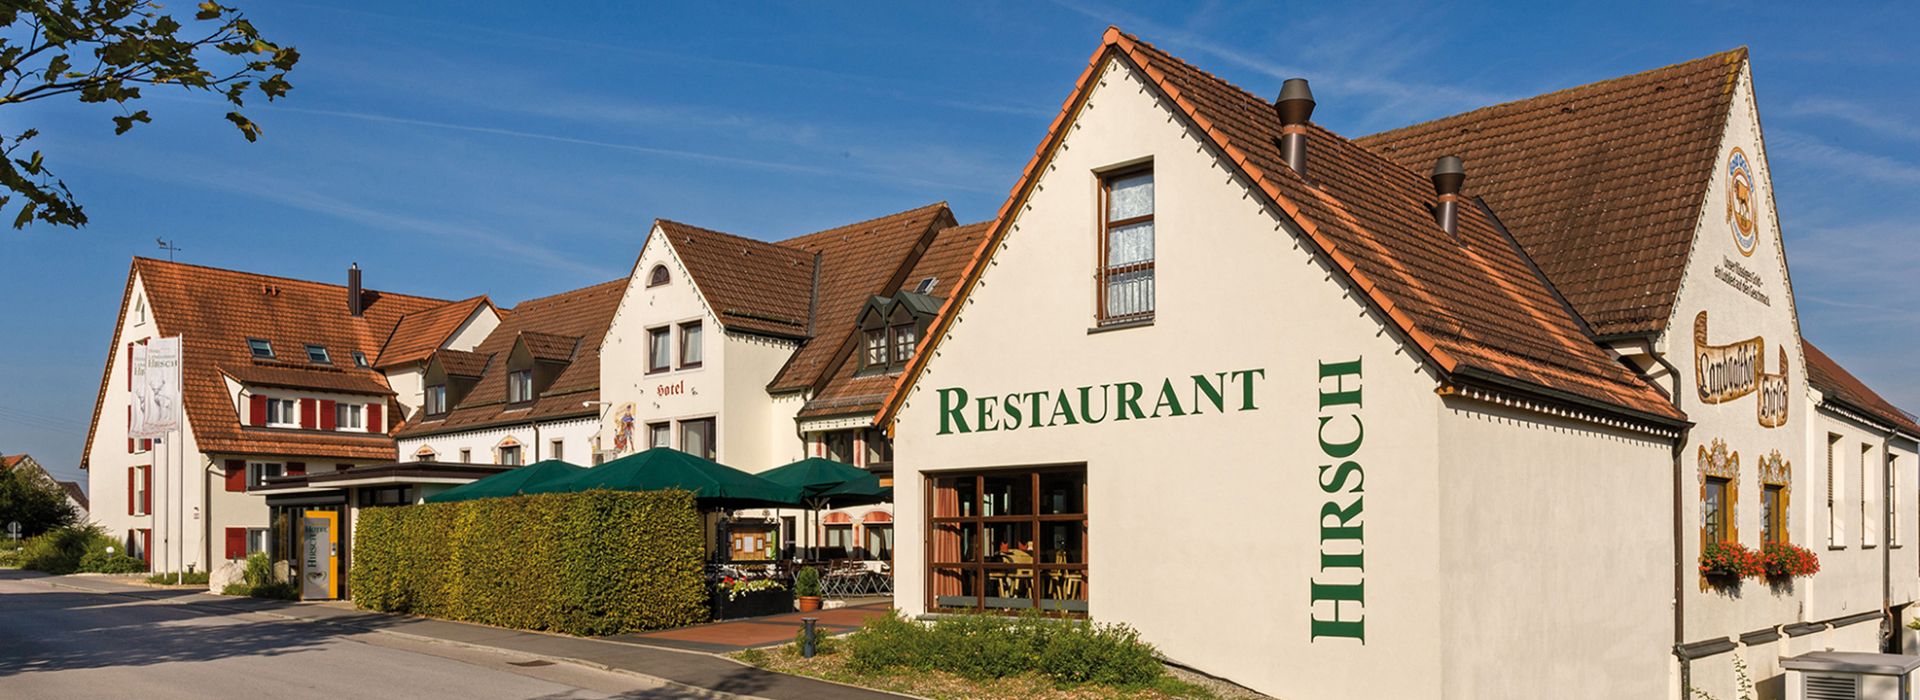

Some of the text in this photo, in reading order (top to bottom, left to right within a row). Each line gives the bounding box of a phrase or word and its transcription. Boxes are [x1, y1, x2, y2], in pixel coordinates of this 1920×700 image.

[656, 380, 684, 397] Hotel
[936, 368, 1266, 435] RESTAURANT
[1310, 355, 1365, 646] HIRSCH
